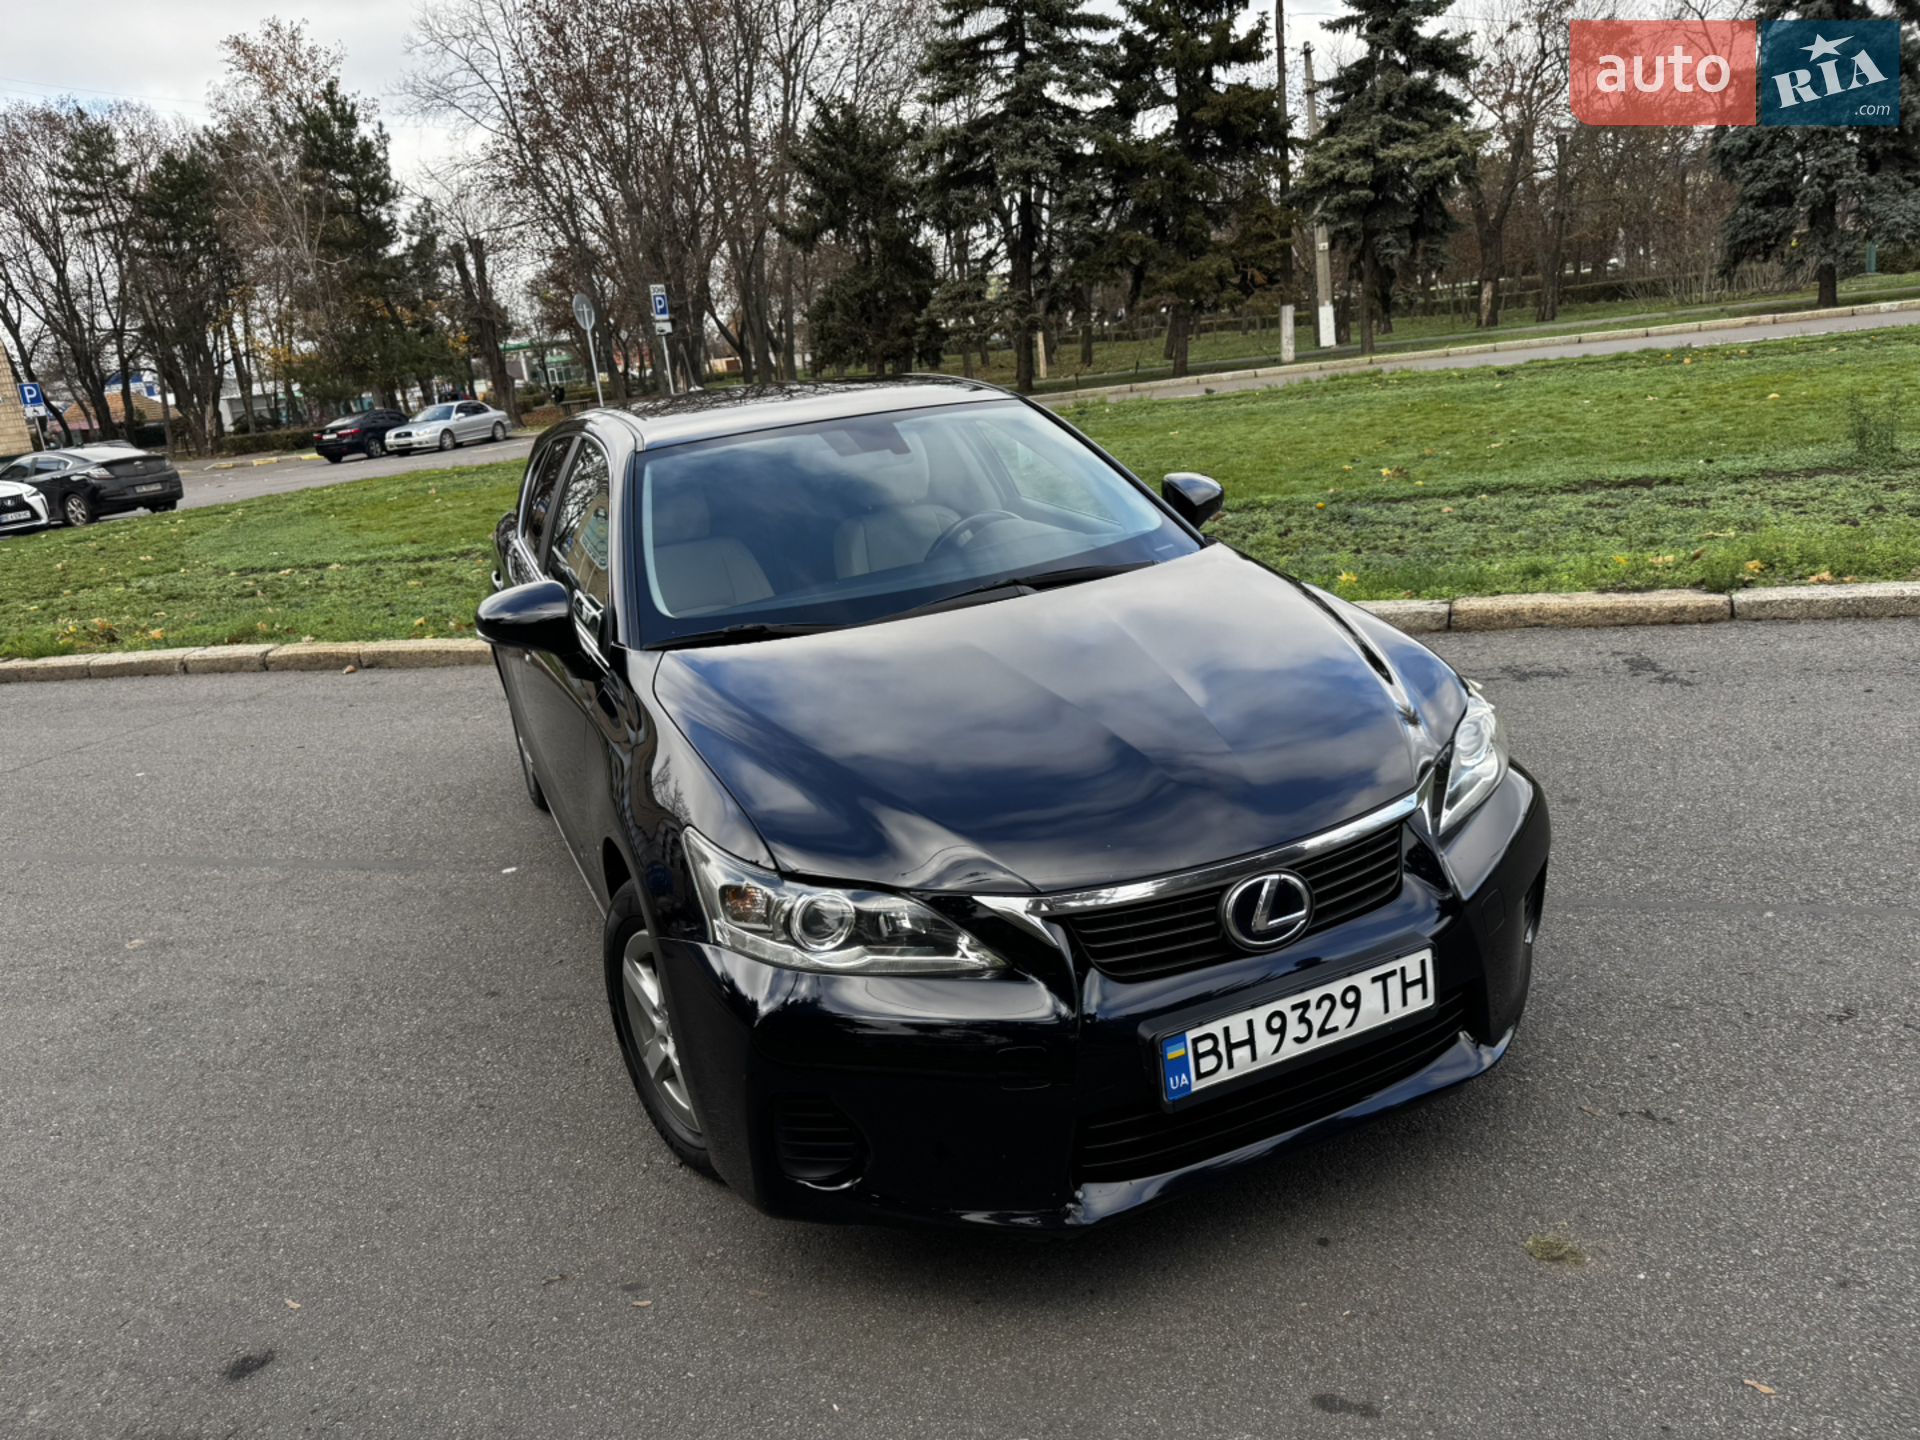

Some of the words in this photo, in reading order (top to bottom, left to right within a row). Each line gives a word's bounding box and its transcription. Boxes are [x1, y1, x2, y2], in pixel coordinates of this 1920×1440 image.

[655, 296, 665, 314] P
[23, 385, 37, 404] P
[1190, 1018, 1258, 1082] BH
[1265, 984, 1362, 1056] 9329
[1371, 958, 1429, 1015] TH
[1169, 1072, 1189, 1090] UA
